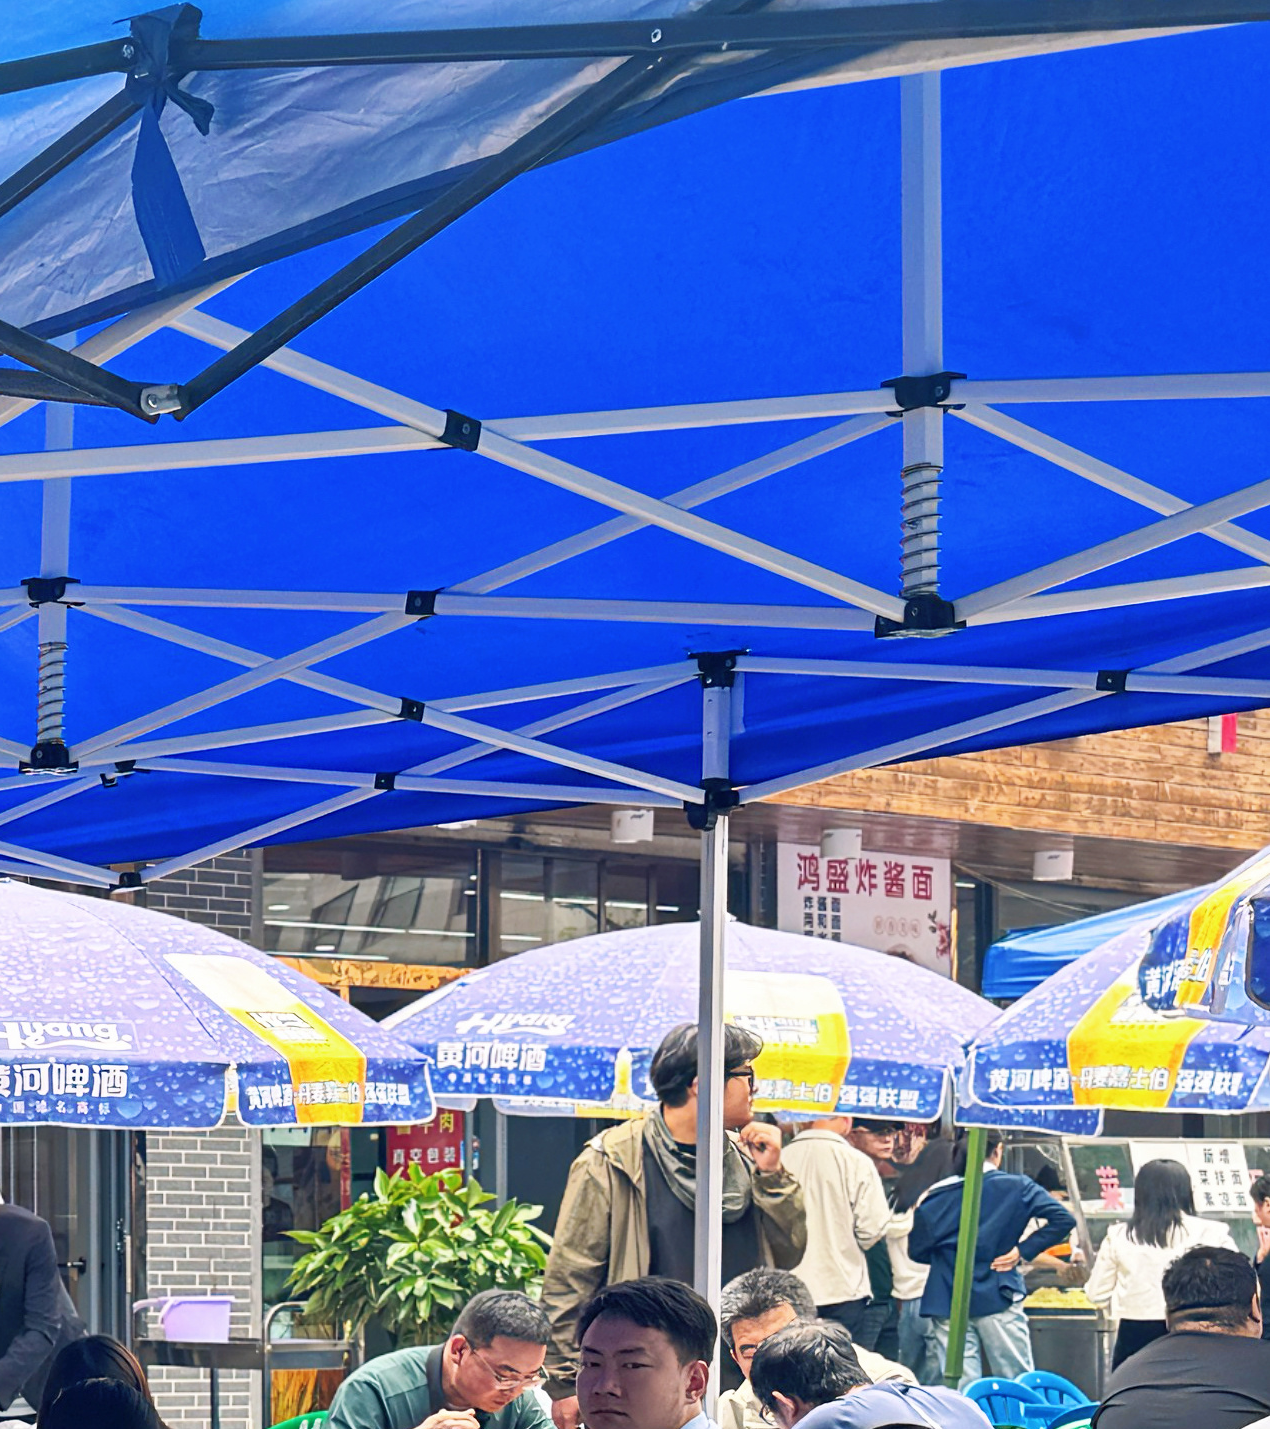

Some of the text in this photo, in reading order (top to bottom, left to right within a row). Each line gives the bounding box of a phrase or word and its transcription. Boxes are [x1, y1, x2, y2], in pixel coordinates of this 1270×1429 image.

[797, 853, 934, 900] 鸿盛炸酱面
[437, 1040, 549, 1072] 黄河啤酒
[839, 1083, 920, 1111] 强强联盟
